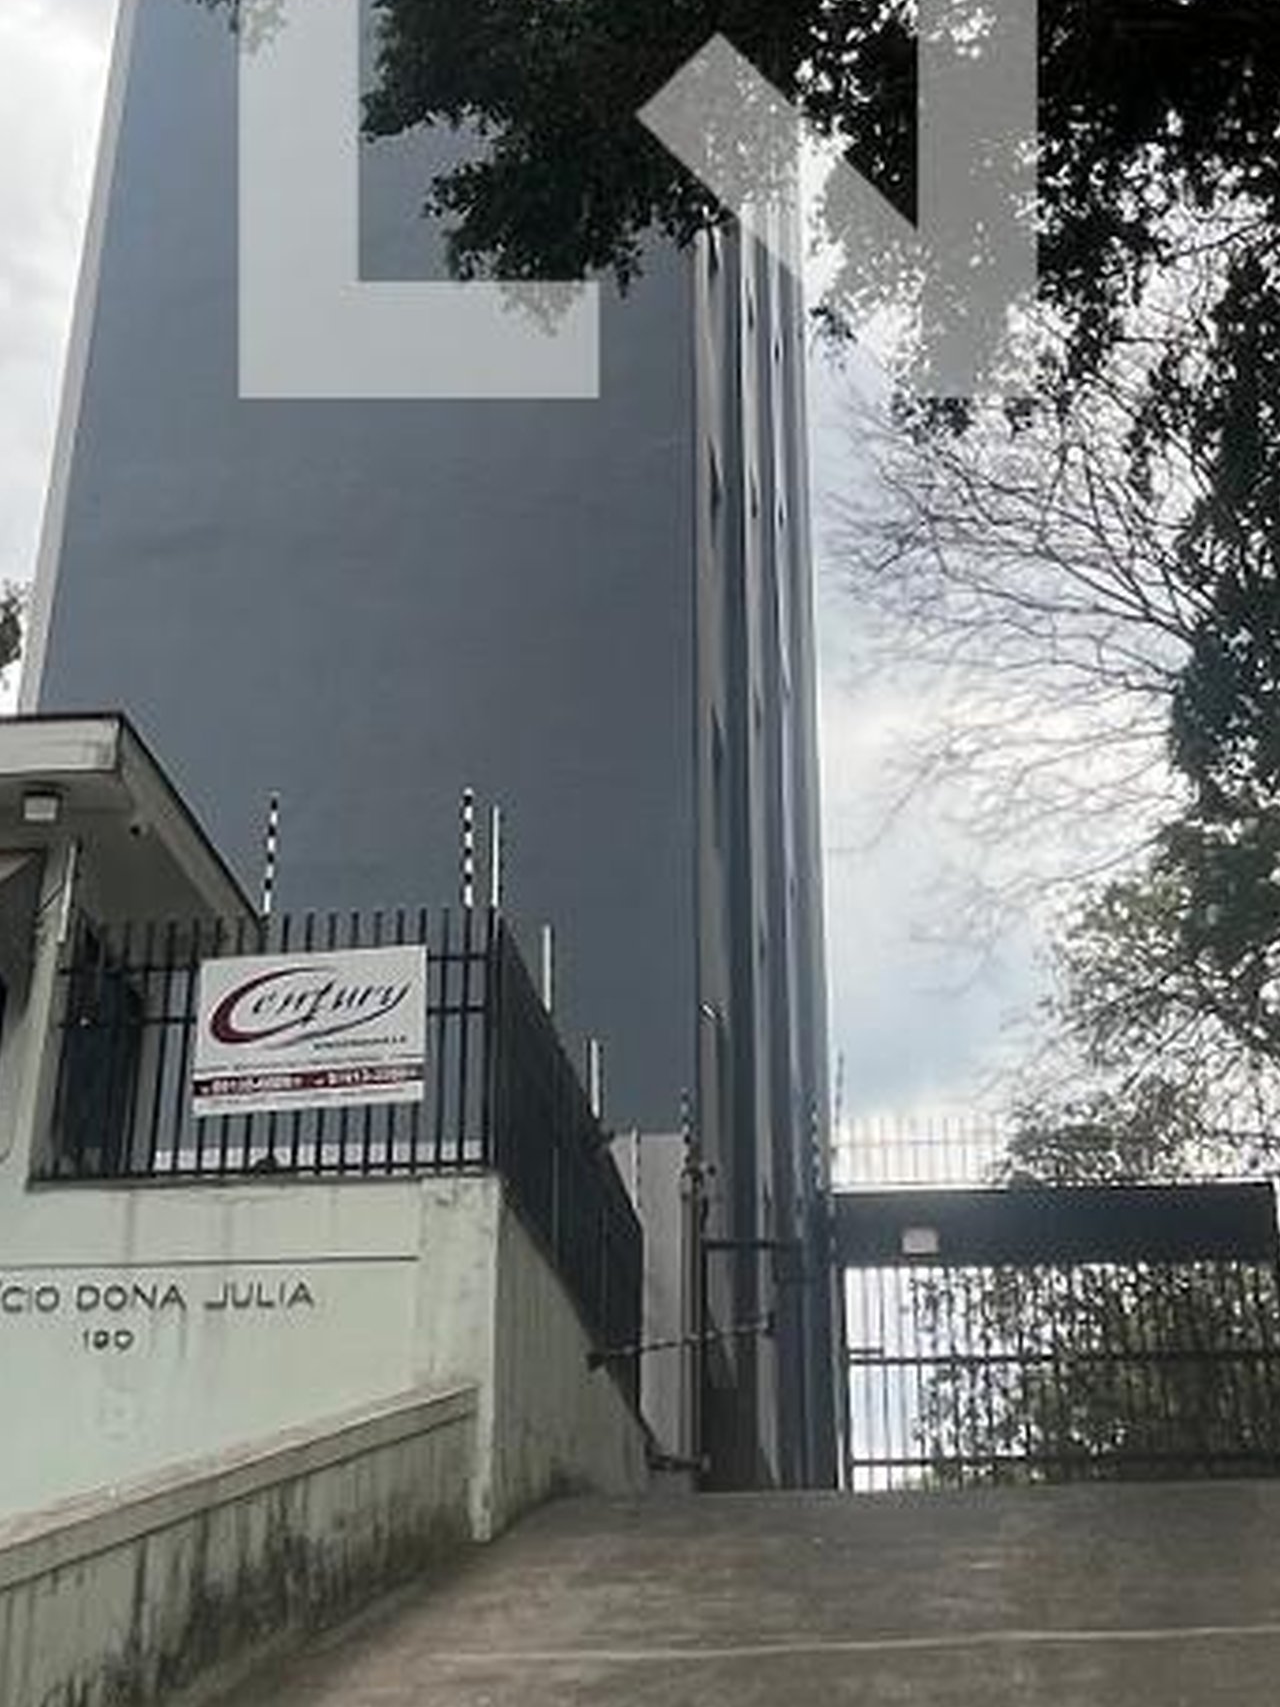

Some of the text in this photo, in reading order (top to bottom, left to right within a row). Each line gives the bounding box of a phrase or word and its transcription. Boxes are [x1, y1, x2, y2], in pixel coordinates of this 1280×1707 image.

[210, 964, 412, 1048] Century
[75, 1284, 187, 1312] DONA
[203, 1281, 315, 1311] JULIA
